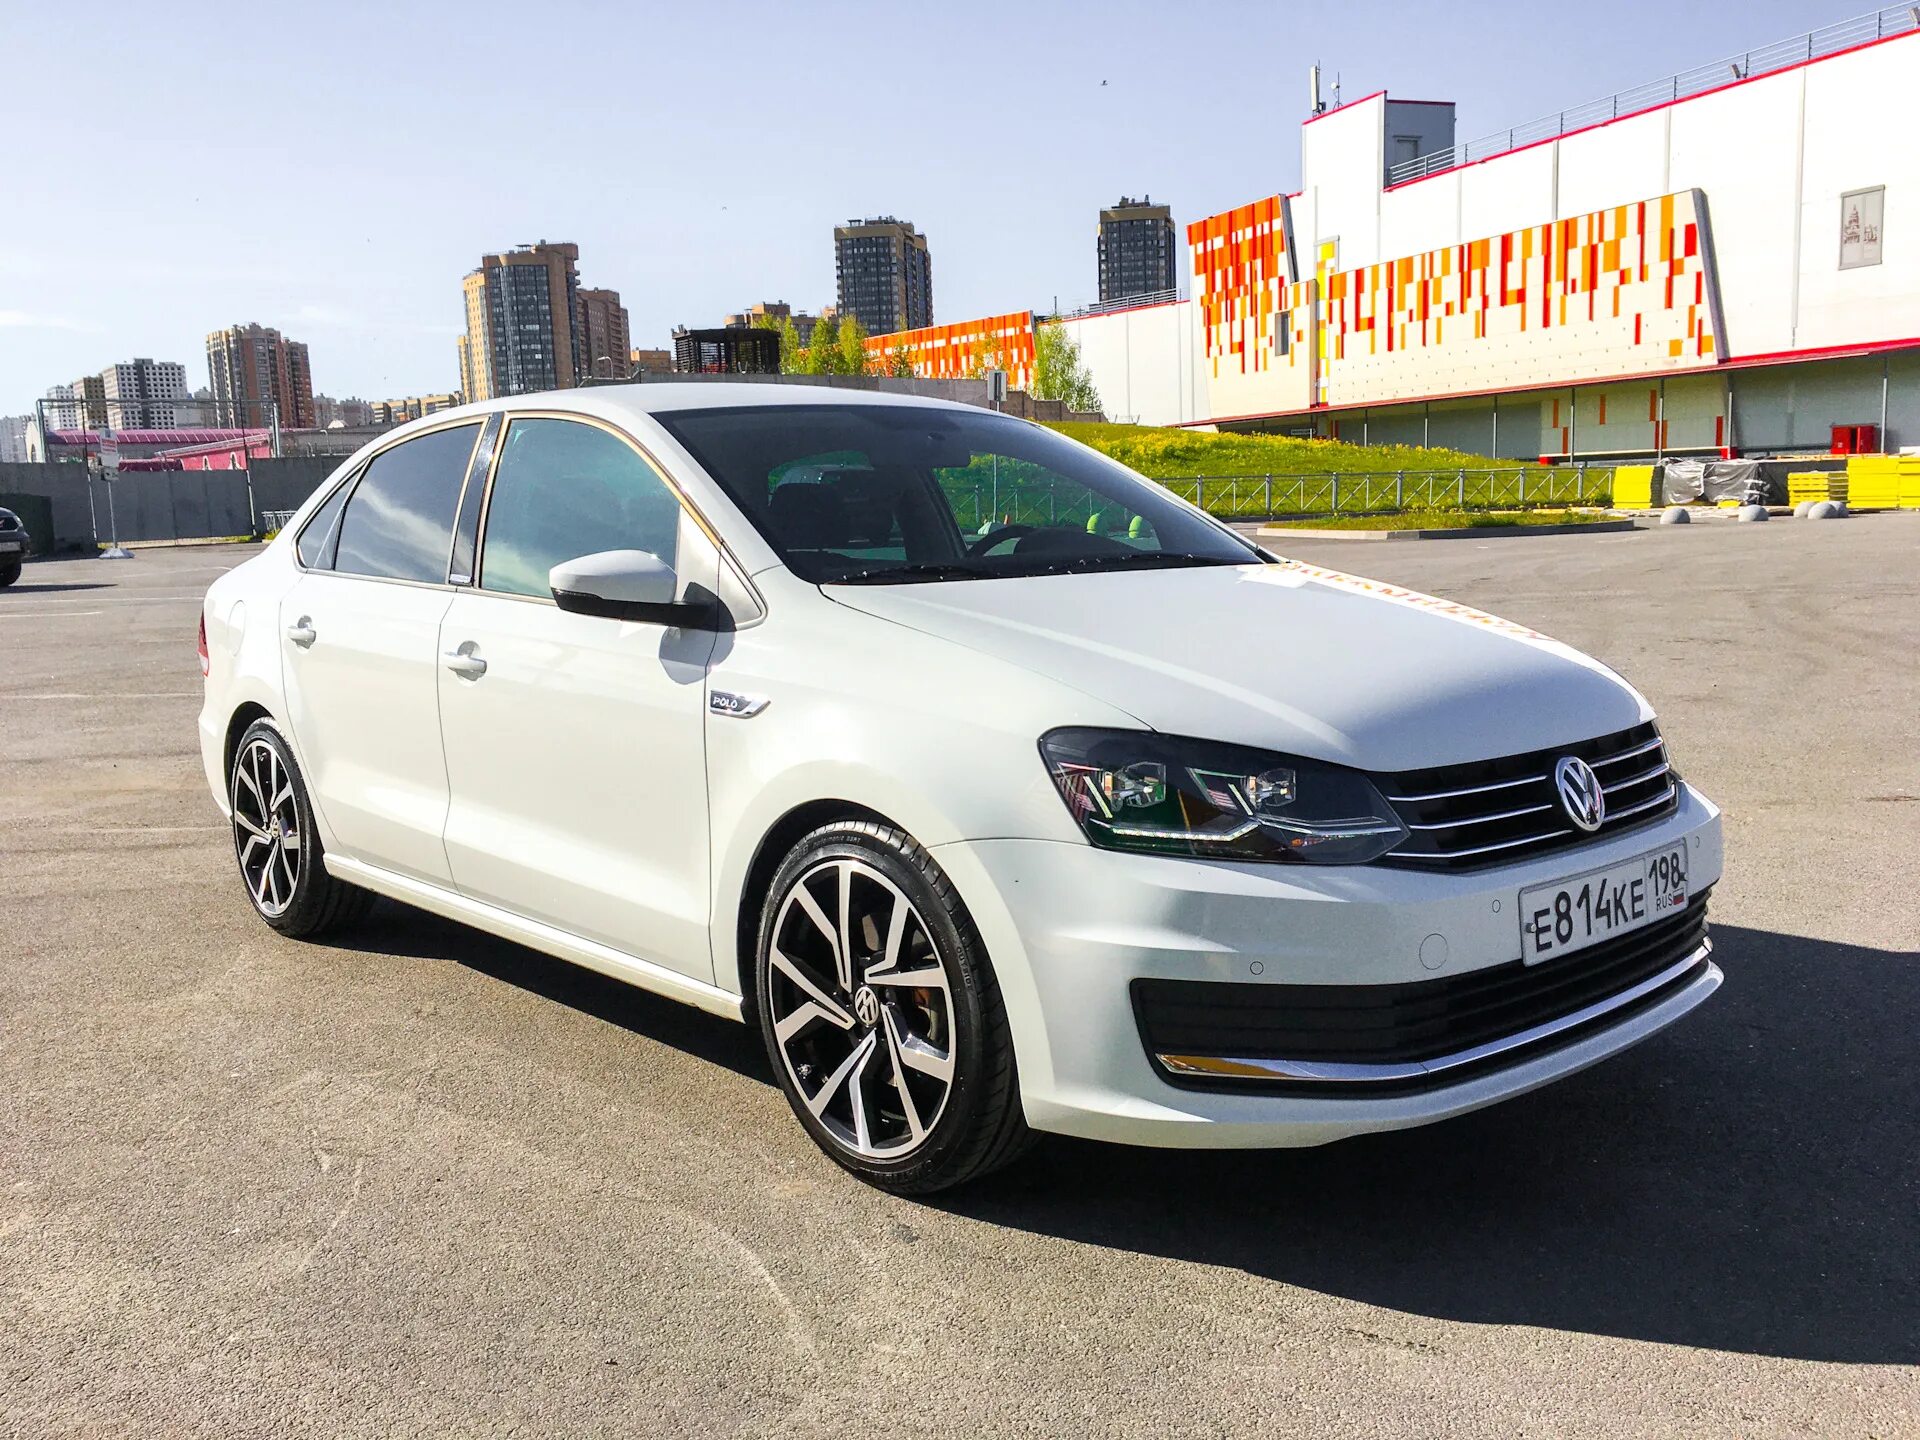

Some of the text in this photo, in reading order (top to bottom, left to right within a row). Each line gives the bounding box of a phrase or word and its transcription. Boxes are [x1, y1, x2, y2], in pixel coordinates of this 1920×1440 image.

[712, 696, 738, 709] POLO
[1534, 852, 1681, 953] E814KE 198
[1655, 895, 1673, 911] RUS
